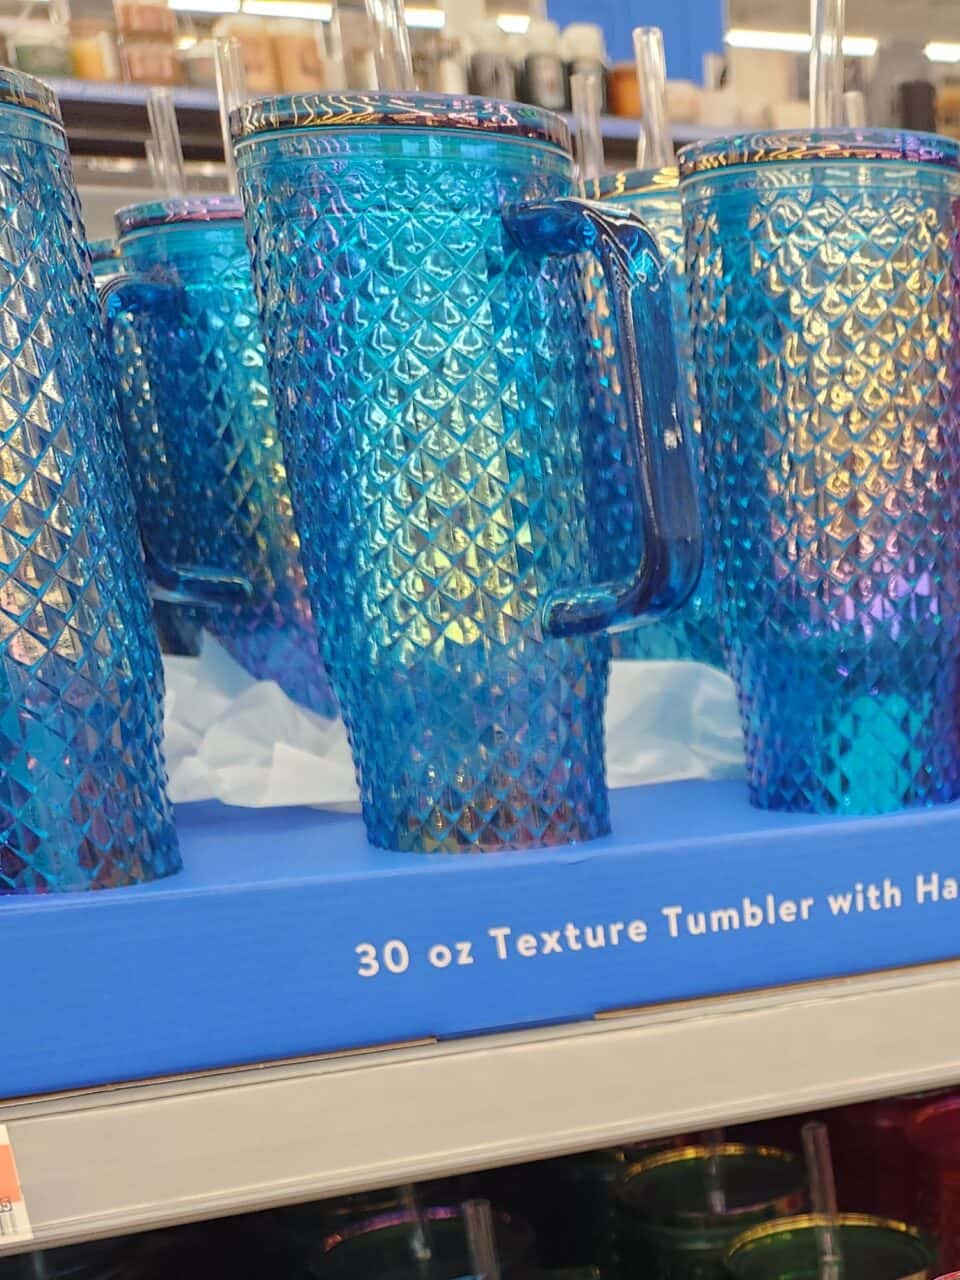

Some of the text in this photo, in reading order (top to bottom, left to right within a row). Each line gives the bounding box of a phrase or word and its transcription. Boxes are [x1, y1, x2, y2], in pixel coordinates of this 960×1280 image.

[355, 939, 410, 977] 30
[428, 941, 474, 968] oz
[488, 919, 648, 960] Texture
[661, 894, 814, 938] Tumbler
[827, 879, 902, 916] with
